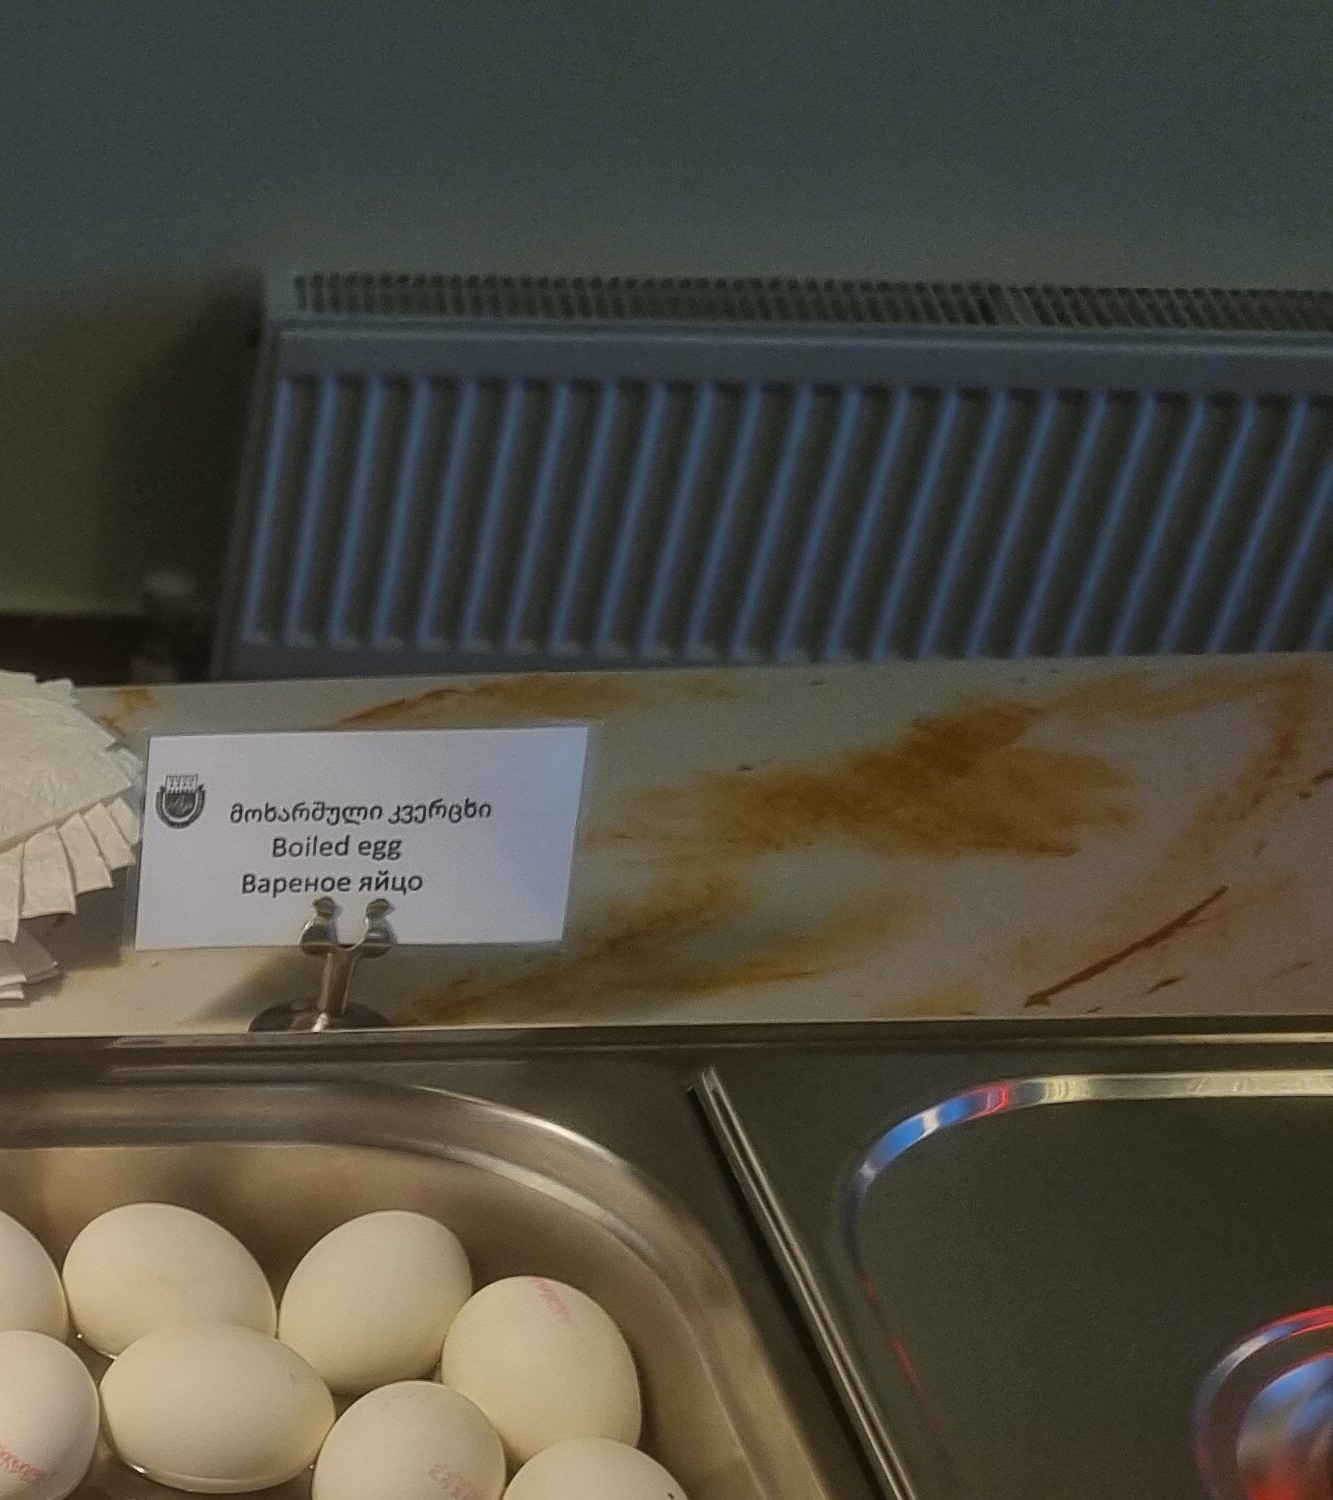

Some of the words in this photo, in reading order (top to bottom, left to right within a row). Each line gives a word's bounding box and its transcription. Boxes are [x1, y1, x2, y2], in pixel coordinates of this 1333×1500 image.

[230, 801, 383, 826] მოხარშული
[388, 798, 493, 824] კვერცხი
[272, 835, 351, 858] Boiled
[357, 839, 403, 861] egg
[241, 873, 352, 898] Вареное
[357, 870, 424, 895] яйцо
